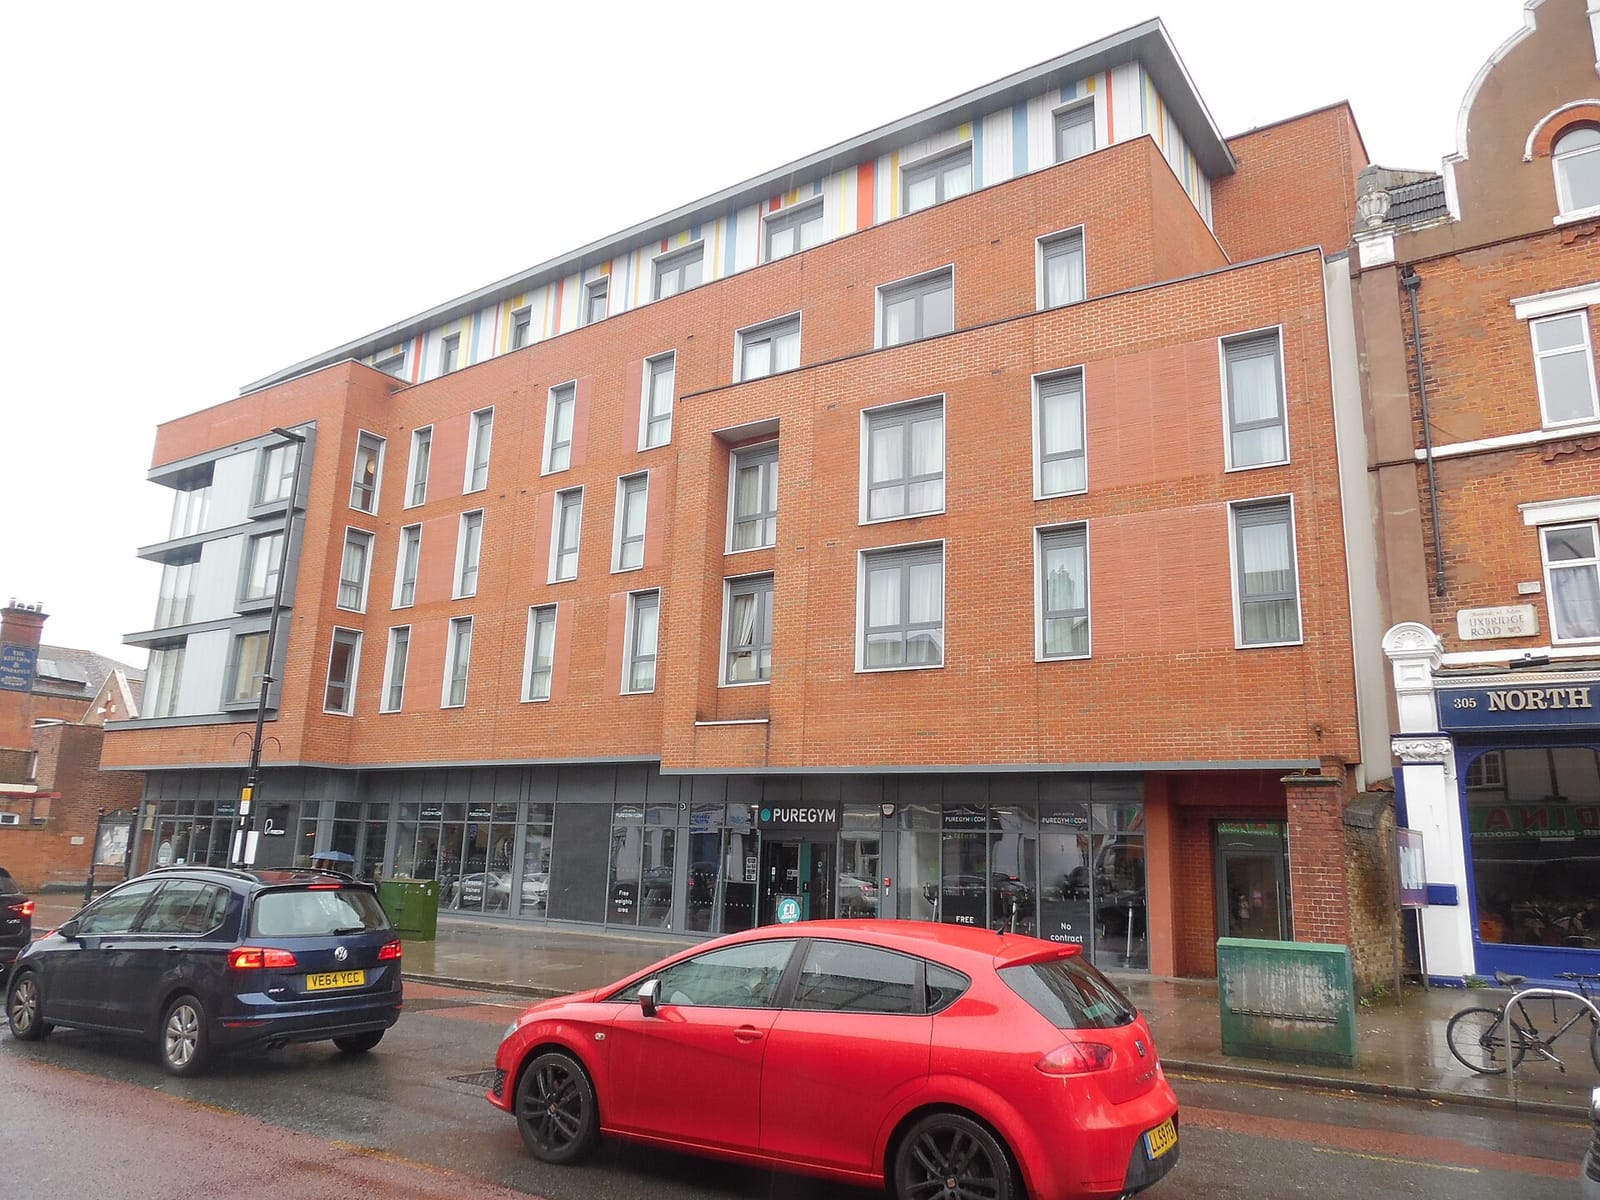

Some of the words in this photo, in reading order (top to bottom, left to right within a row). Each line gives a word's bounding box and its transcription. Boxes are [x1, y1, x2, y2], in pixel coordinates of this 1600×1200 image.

[1469, 614, 1525, 627] UXBRIDGE
[1471, 626, 1502, 637] ROAD
[1453, 697, 1477, 709] 305
[1486, 687, 1593, 711] NORTH
[772, 807, 836, 823] PUREGYM
[955, 915, 975, 924] FREE
[1060, 922, 1072, 931] No
[1050, 934, 1083, 943] contract
[311, 974, 338, 987] VE64
[341, 972, 360, 984] YCC
